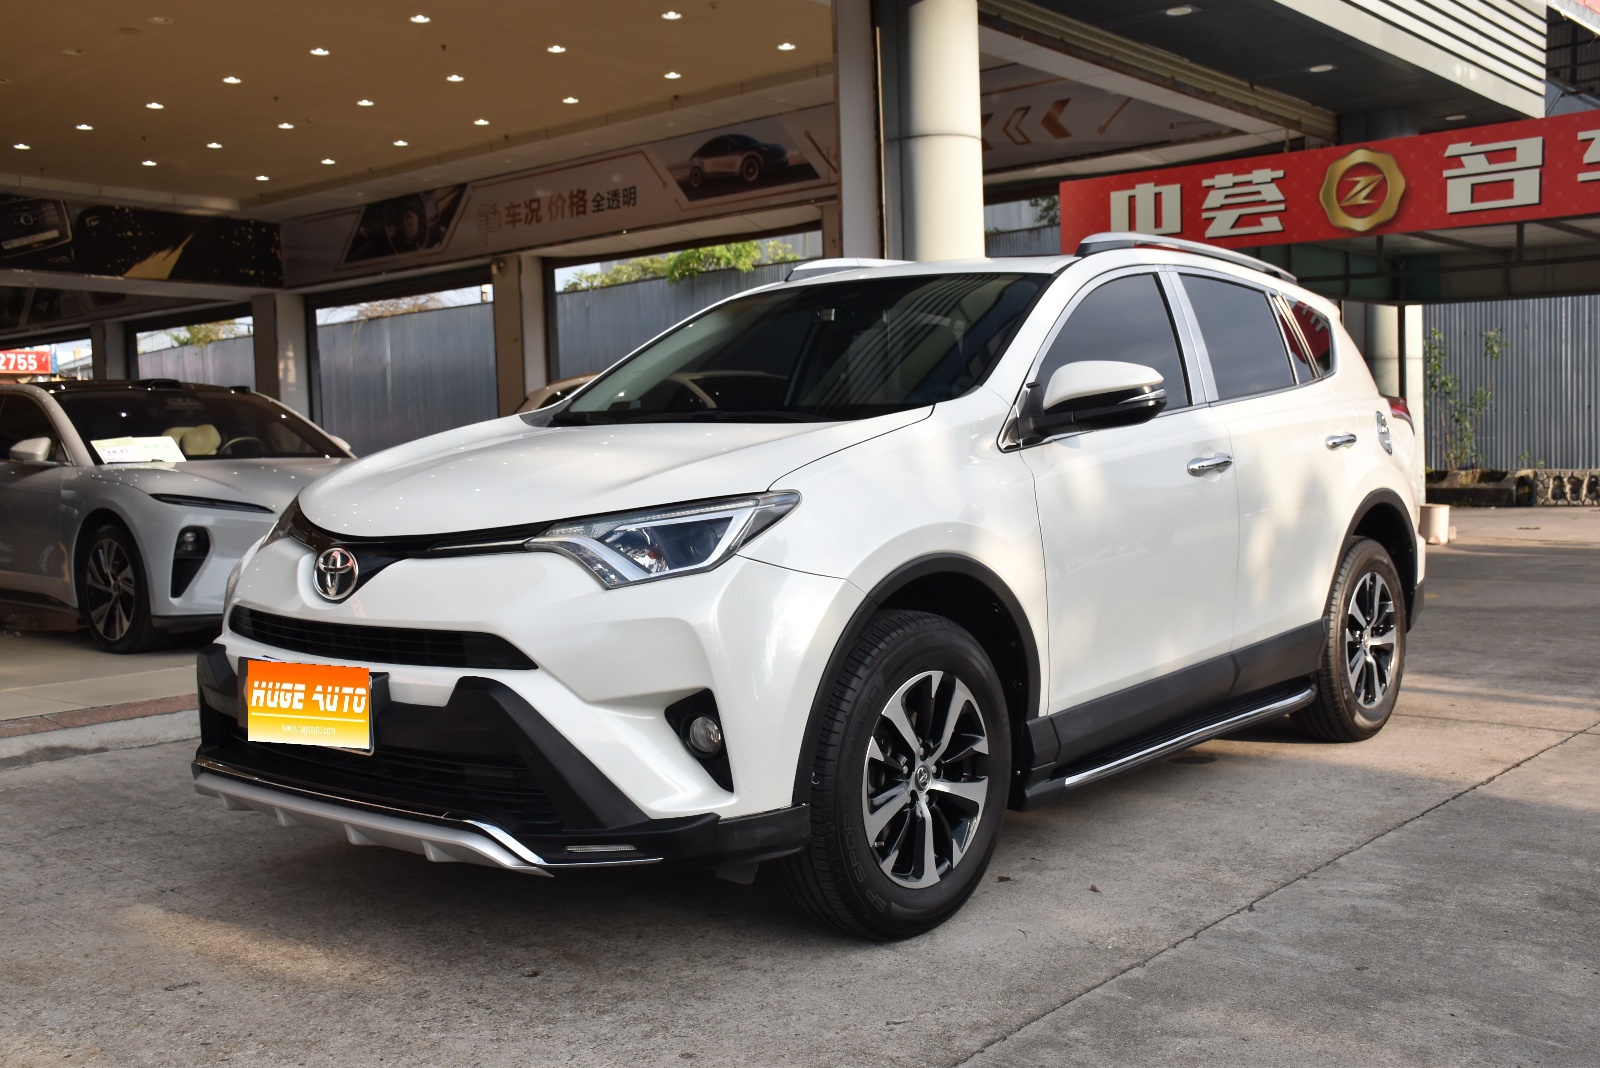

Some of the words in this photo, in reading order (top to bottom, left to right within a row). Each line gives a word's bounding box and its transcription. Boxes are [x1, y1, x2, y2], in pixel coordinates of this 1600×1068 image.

[1443, 129, 1600, 213] 名
[505, 198, 542, 228] 车况
[548, 188, 588, 221] 价格
[592, 186, 637, 213] 全透明
